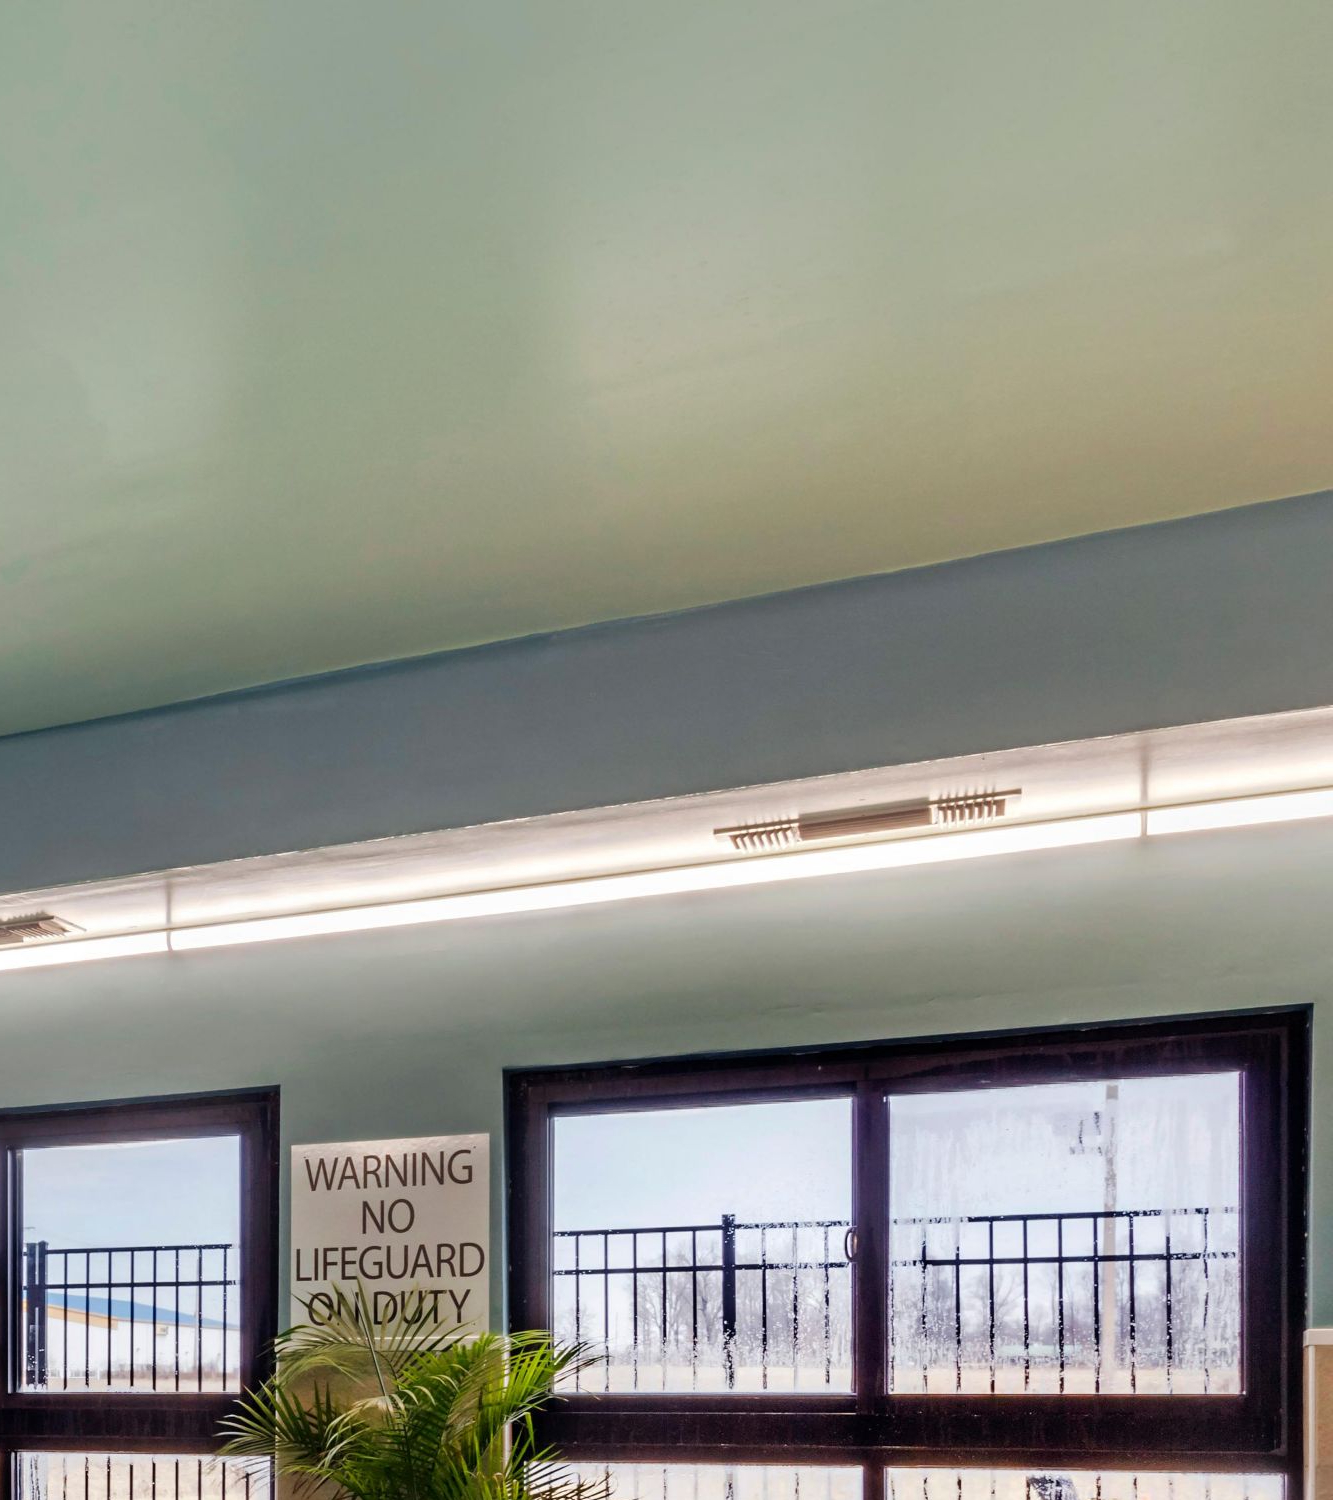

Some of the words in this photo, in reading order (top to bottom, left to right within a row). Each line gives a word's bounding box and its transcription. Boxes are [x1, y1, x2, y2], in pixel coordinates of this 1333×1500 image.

[305, 1150, 473, 1191] WARNING
[362, 1199, 415, 1234] NO
[296, 1243, 484, 1281] LIFEGUARD
